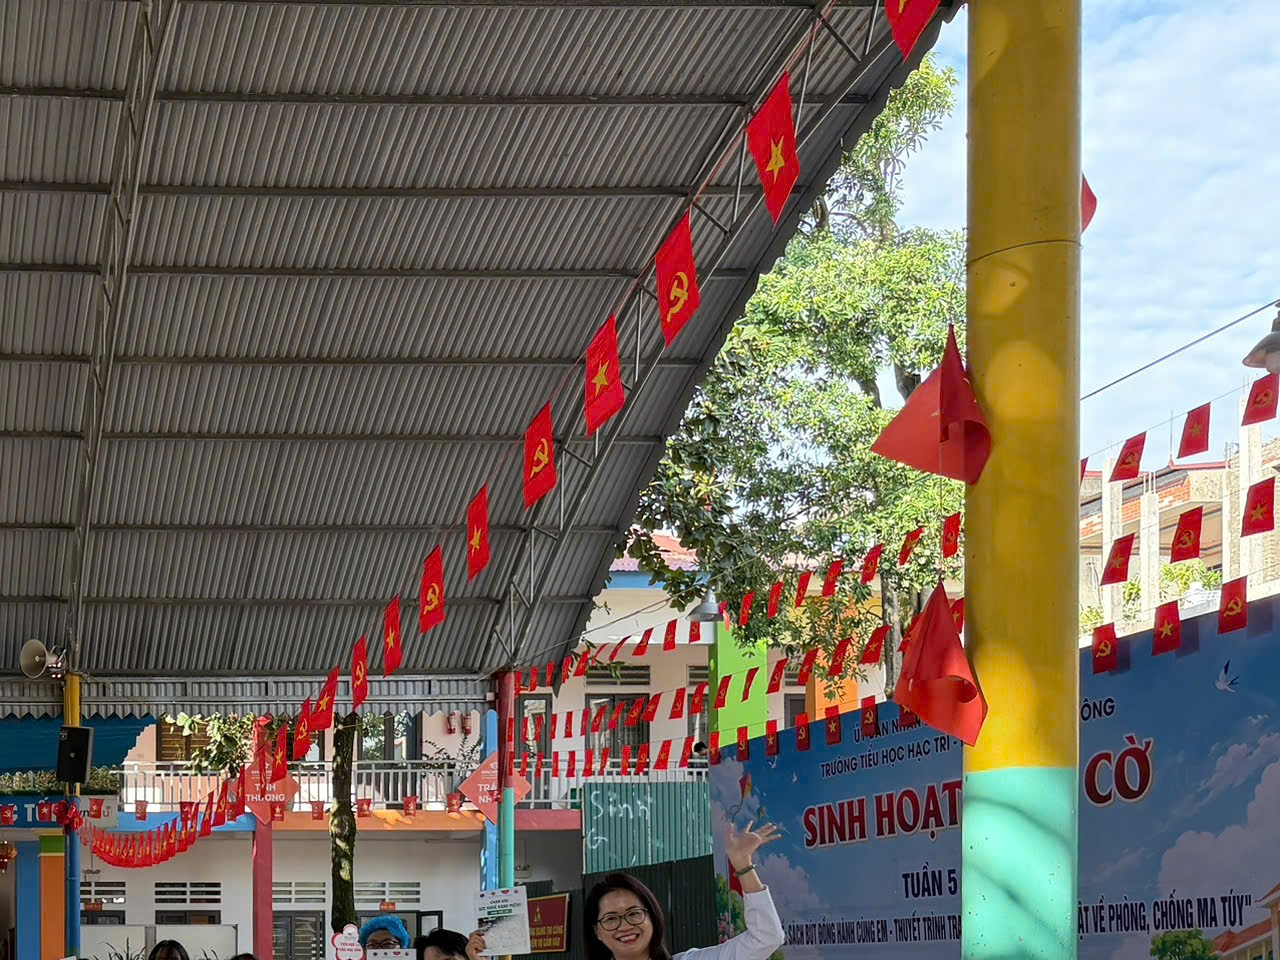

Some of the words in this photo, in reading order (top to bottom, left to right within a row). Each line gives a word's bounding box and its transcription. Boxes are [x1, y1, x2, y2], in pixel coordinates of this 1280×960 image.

[1080, 698, 1115, 721] ÔNG
[821, 756, 858, 778] TRƯỜNG
[860, 744, 878, 768] TIỂU
[882, 748, 904, 767] HỌC
[908, 740, 930, 761] HẠC
[803, 798, 867, 847] SINH
[875, 780, 962, 839] HOẠT
[1084, 735, 1152, 804] CỜ
[902, 862, 942, 898] TUẦN
[948, 869, 957, 895] 5
[856, 916, 875, 942] CÙNG
[877, 920, 888, 942] EM
[894, 910, 920, 942] THUYẾT
[922, 912, 946, 940] TRÌNH
[948, 915, 962, 939] TRA
[1078, 901, 1089, 940] ẬT
[1092, 896, 1106, 933] VỀ
[1109, 896, 1150, 934] PHÒNG,
[1154, 889, 1192, 930] CHỐNG
[1197, 898, 1218, 928] MA
[1221, 889, 1251, 926] TÚY"
